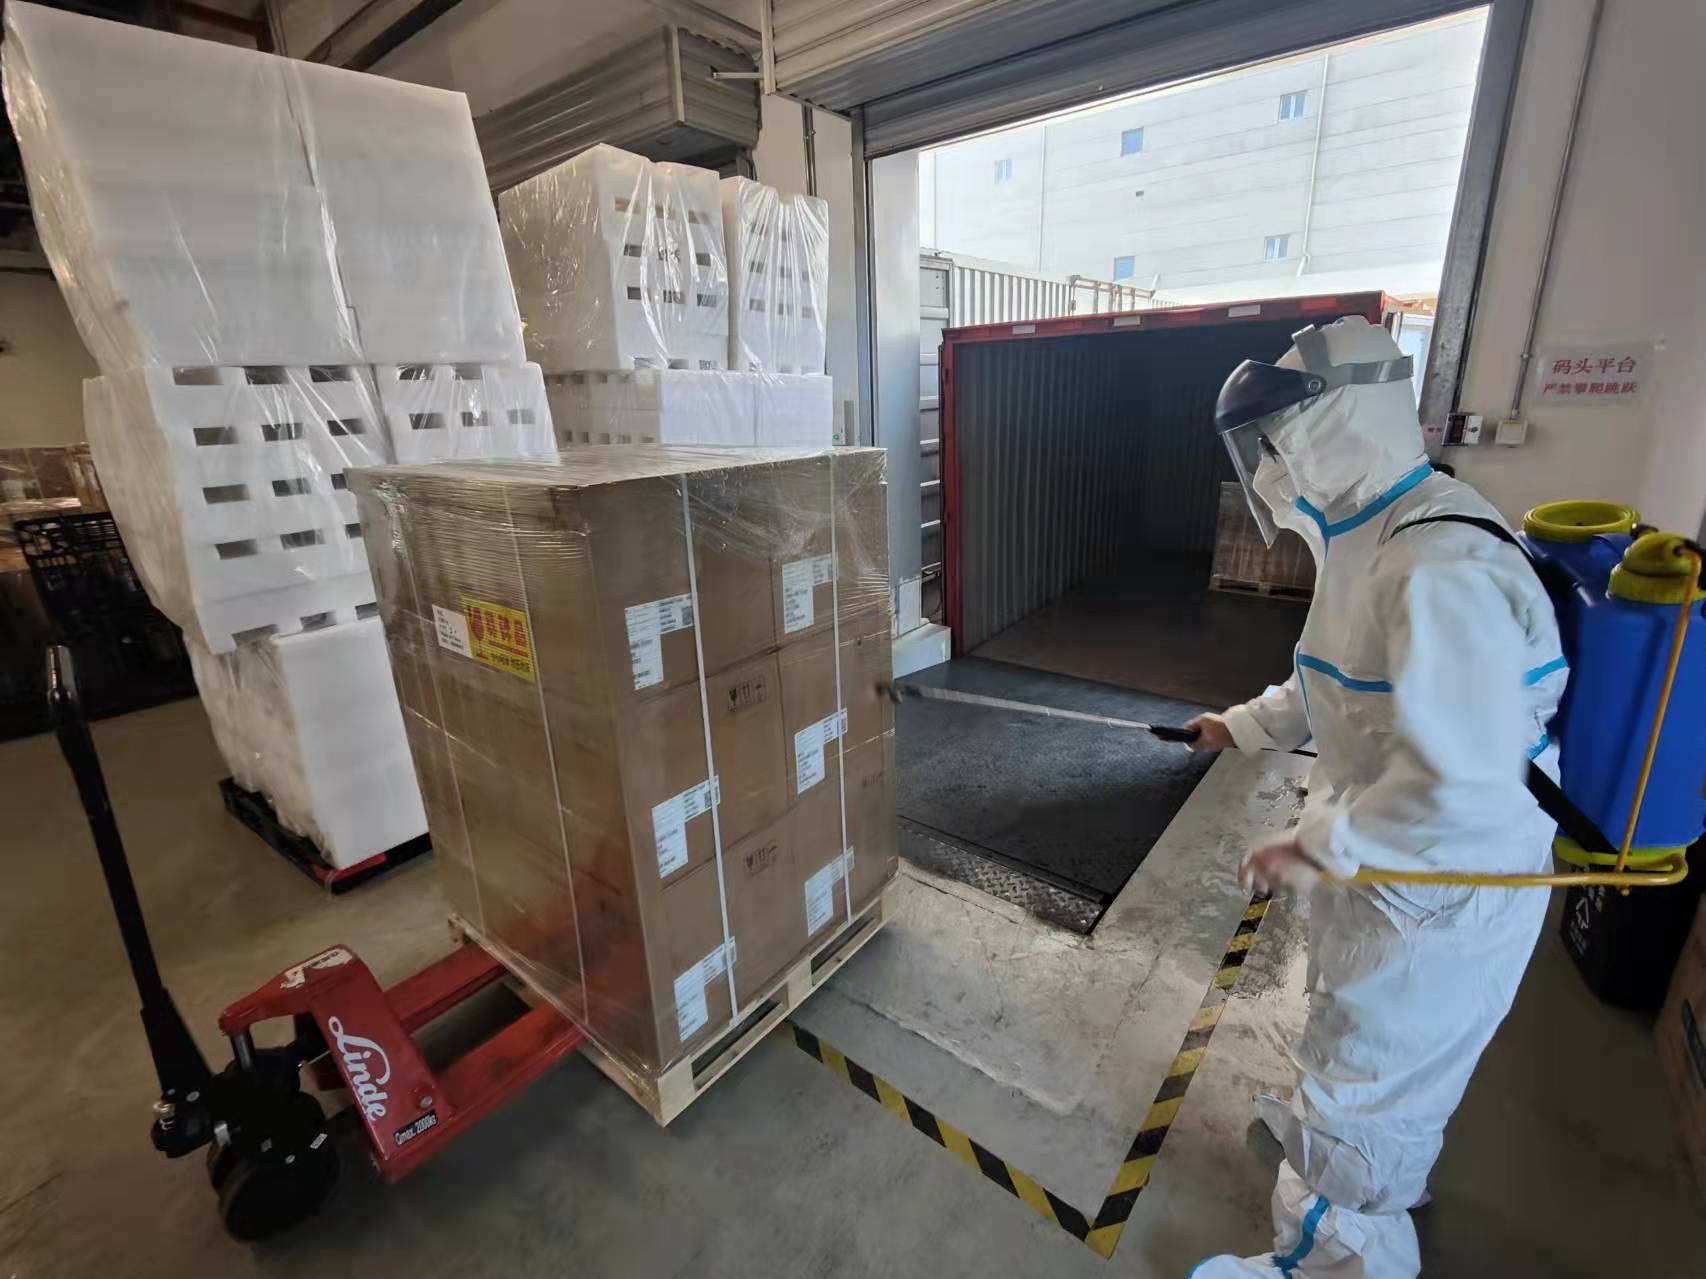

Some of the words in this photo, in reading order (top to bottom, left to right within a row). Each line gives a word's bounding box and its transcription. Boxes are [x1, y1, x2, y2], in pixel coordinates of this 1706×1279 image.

[1552, 356, 1637, 374] 码头平台
[1543, 382, 1638, 394] 严禁攀爬跳跃
[328, 1016, 391, 1121] Linde
